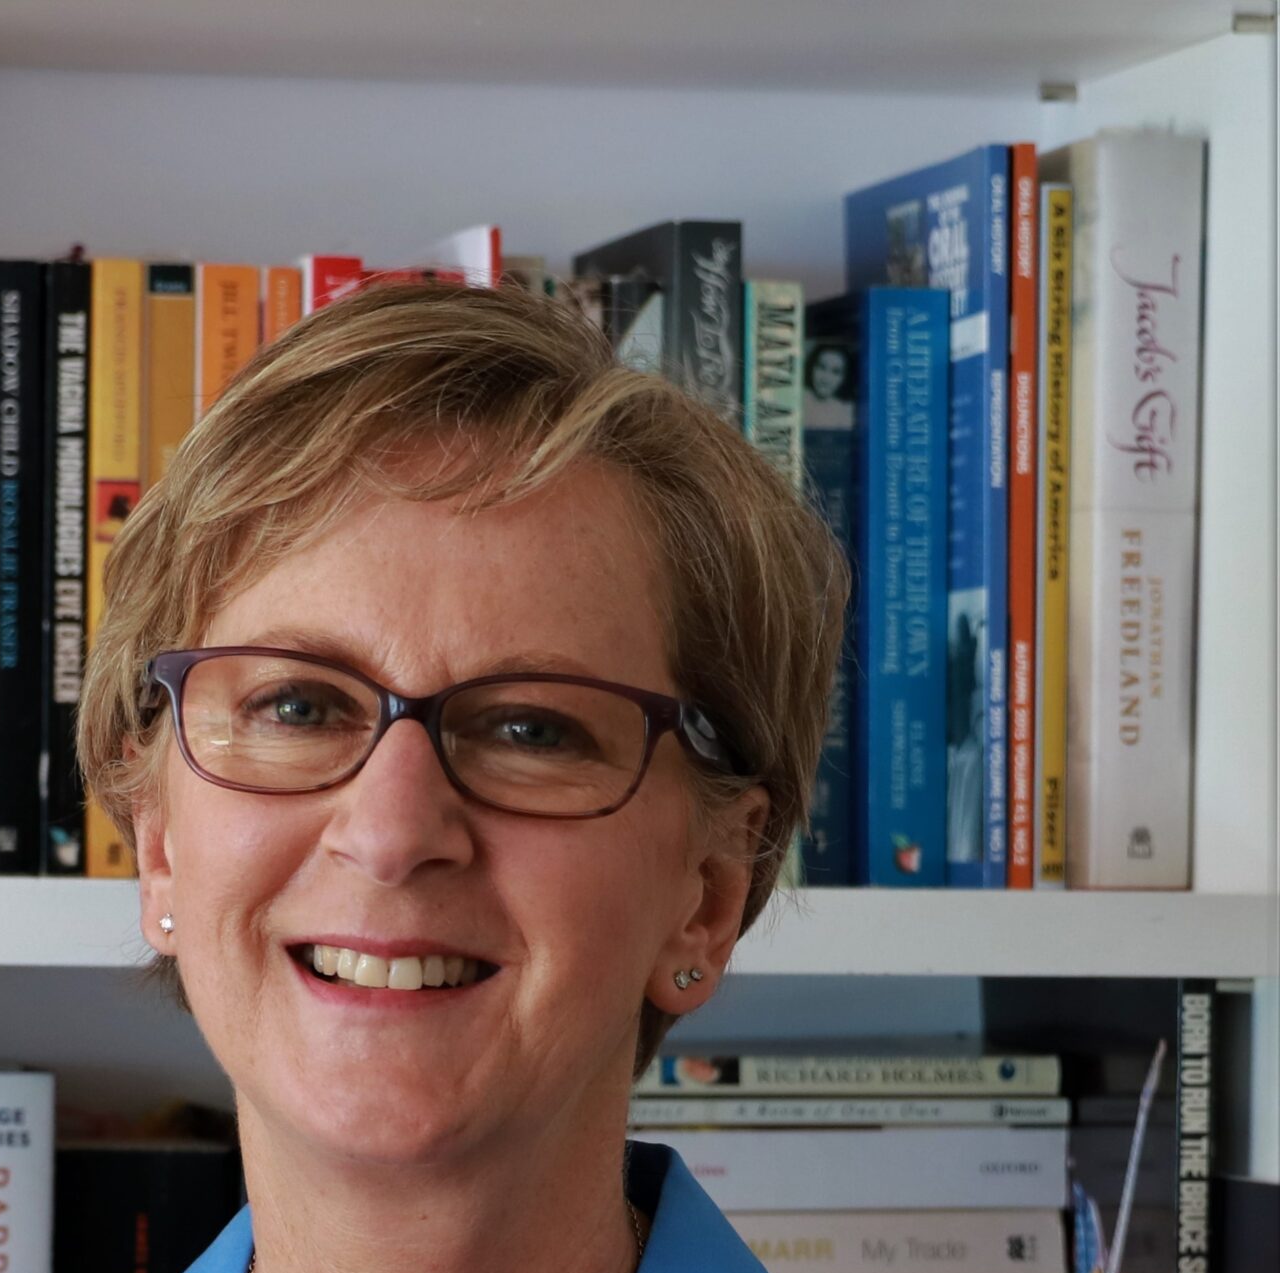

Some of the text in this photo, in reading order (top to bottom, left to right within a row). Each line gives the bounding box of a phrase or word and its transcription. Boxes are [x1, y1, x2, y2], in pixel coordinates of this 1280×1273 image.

[756, 302, 796, 390] MAYA
[1105, 245, 1182, 485] Jacob's Gift
[52, 313, 84, 704] THE VAGINA MONOLOGUES EVE ENSLER
[903, 307, 929, 677] A LITERATURE OF THEIR OWN
[1117, 527, 1143, 749] FREEDLAND
[1147, 576, 1164, 701] JONATHAN
[1180, 993, 1211, 1055] BORN
[756, 1065, 988, 1084] RICHARD HOLMES
[1179, 1056, 1210, 1085] TO
[1179, 1085, 1210, 1135] RUN
[1178, 1136, 1209, 1179] THE
[860, 1238, 896, 1264] My
[906, 1237, 968, 1261] Trade
[1177, 1180, 1208, 1254] BRUCE
